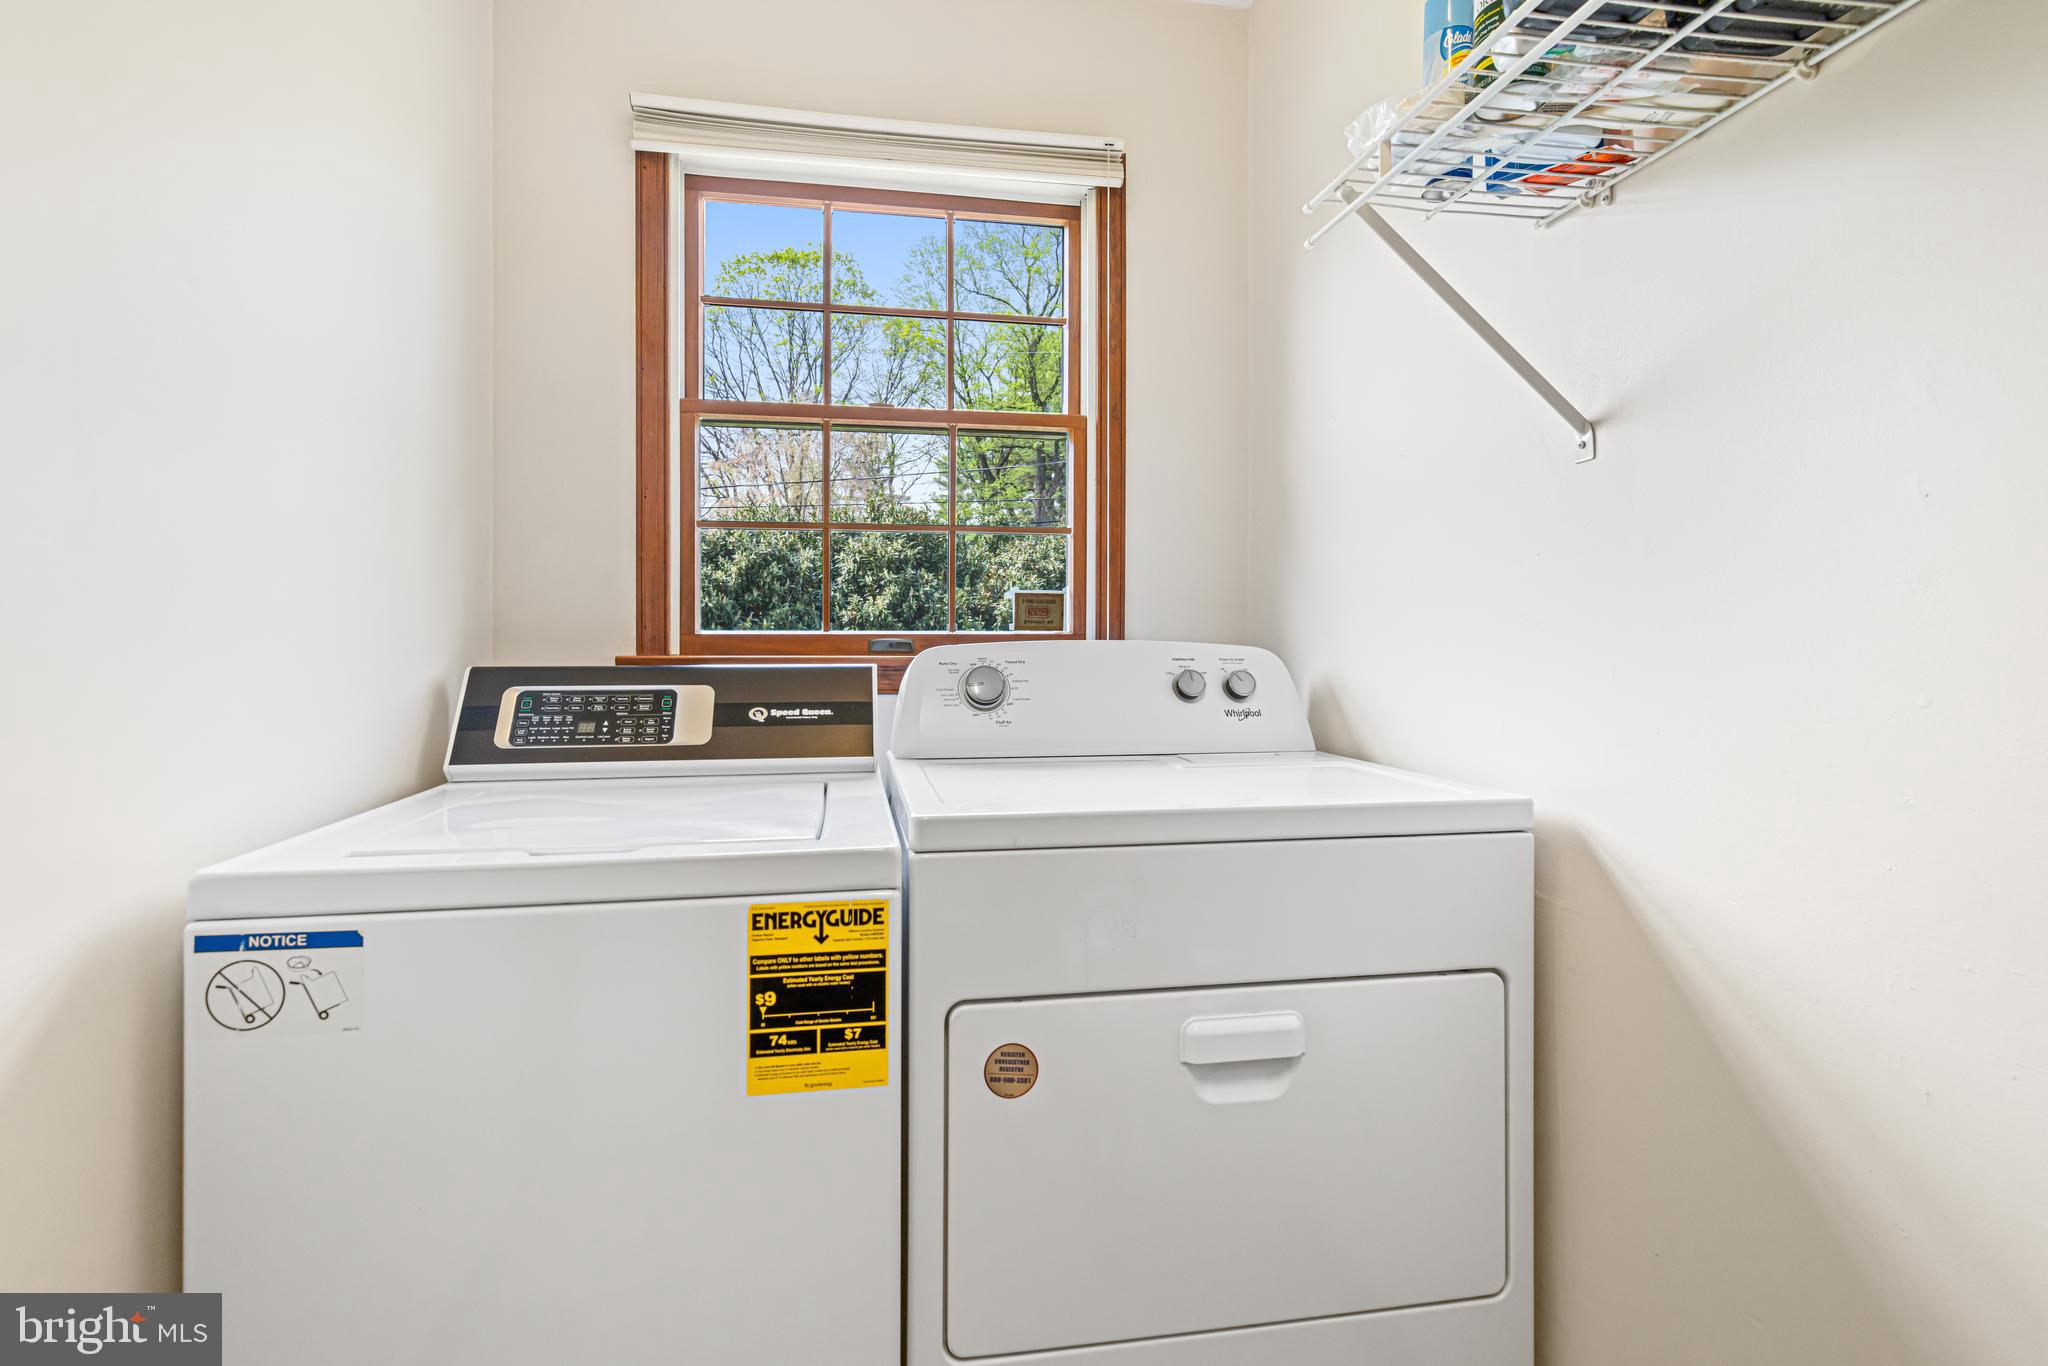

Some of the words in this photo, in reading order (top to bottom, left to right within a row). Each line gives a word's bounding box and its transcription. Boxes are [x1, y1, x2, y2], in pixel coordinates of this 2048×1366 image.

[770, 709, 800, 717] Speed
[1224, 708, 1262, 720] Whirlpool
[752, 908, 885, 933] ENERGYGUIDE
[248, 935, 307, 948] NOTICE
[755, 991, 777, 1007] $9
[769, 1034, 787, 1046] 74
[844, 1028, 862, 1040] $7
